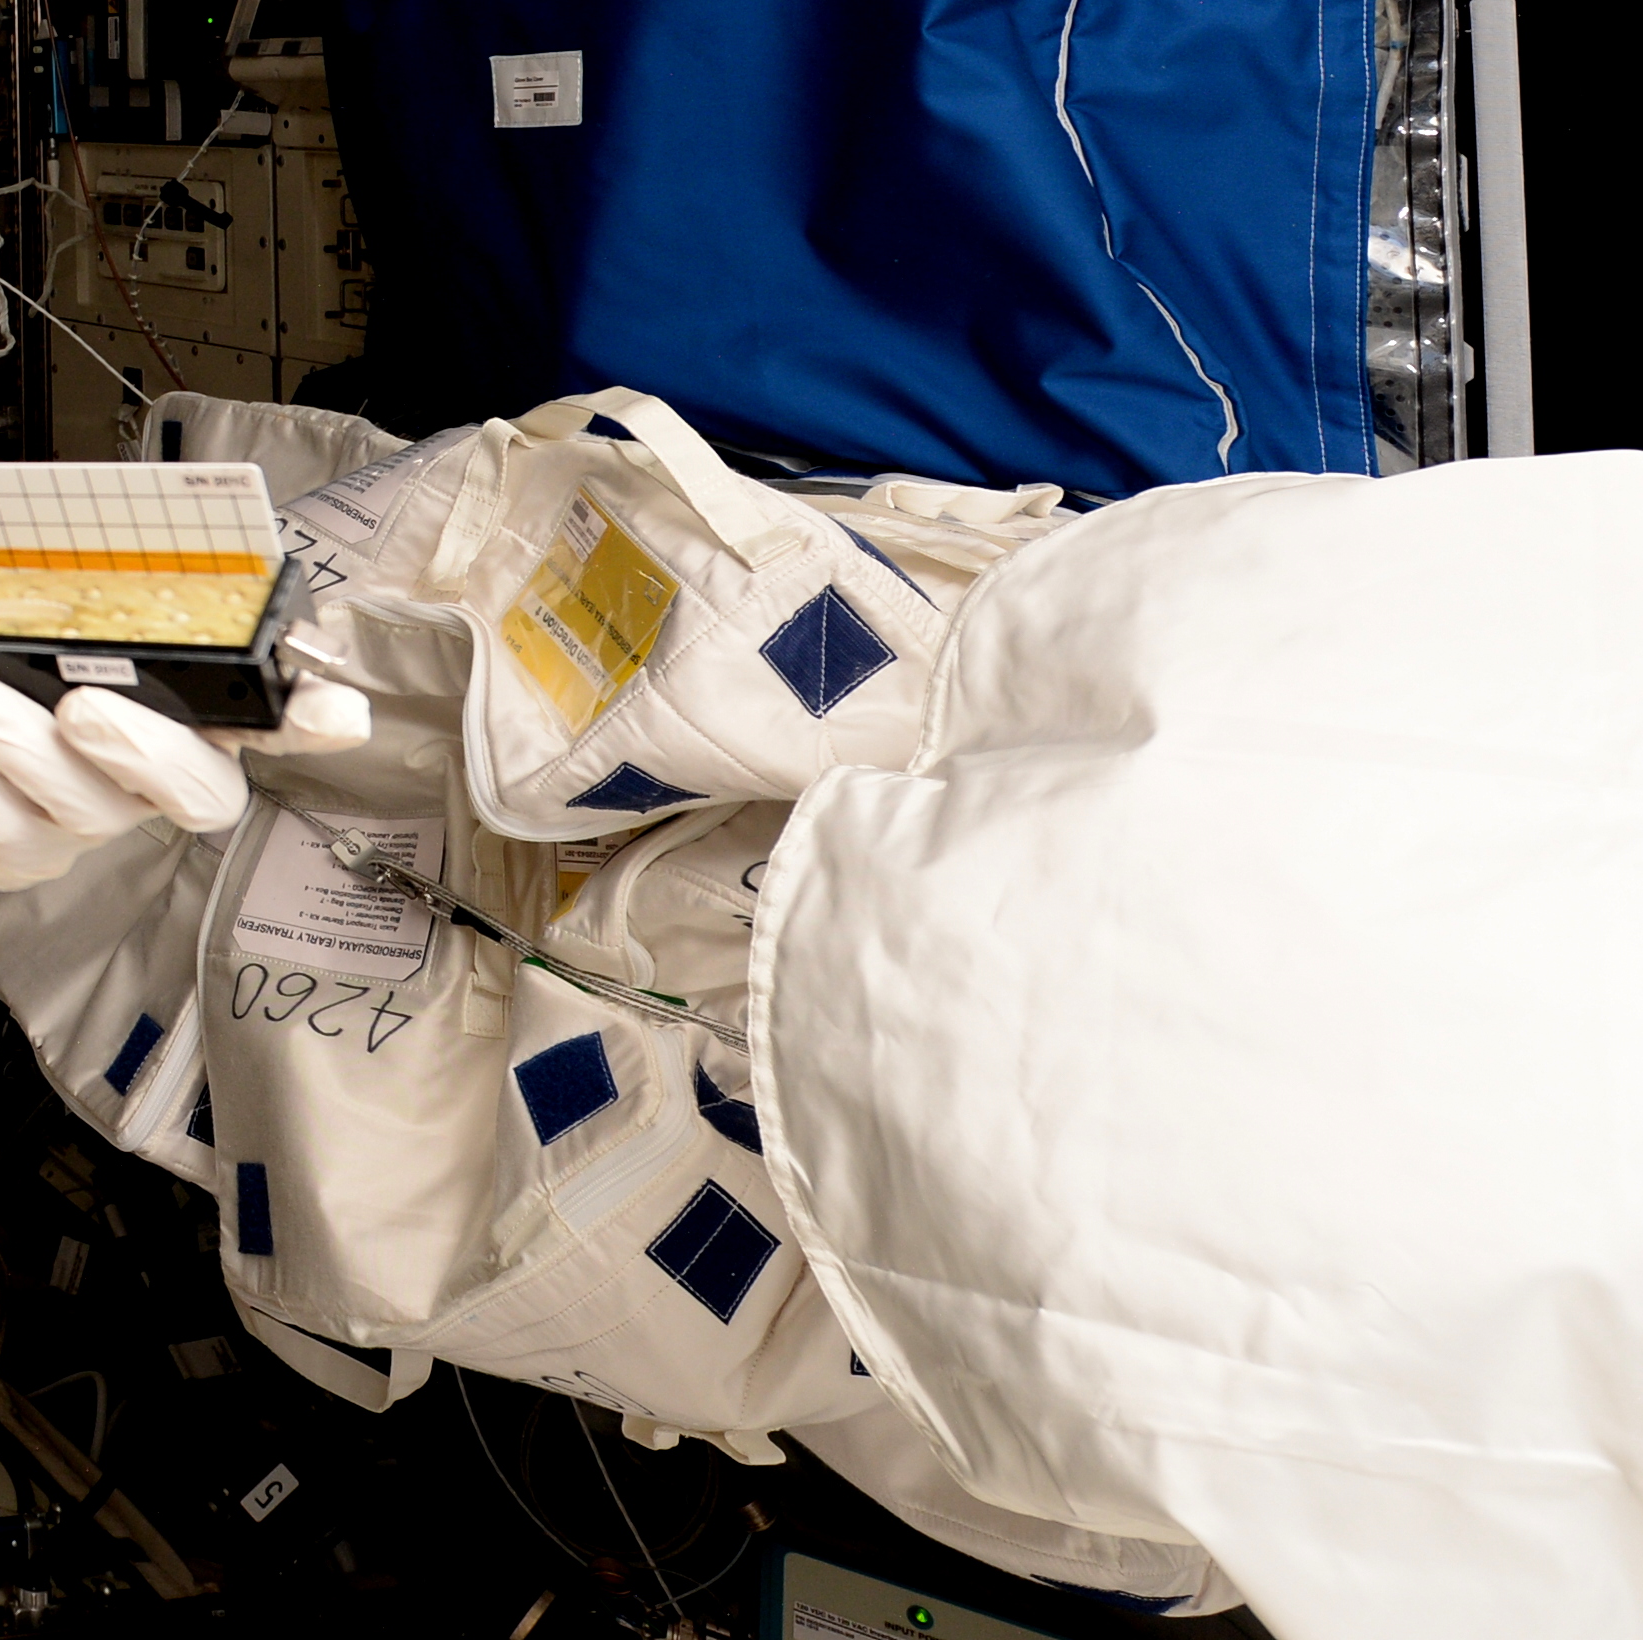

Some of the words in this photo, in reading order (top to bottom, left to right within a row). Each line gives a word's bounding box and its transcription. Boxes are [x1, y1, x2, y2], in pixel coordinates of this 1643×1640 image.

[537, 609, 581, 657] Direction
[571, 648, 606, 684] Launch
[346, 901, 372, 911] Fixation
[357, 912, 390, 922] Dosimeter
[373, 904, 403, 914] Chemical
[236, 916, 295, 941] TRANSFER)
[346, 919, 378, 931] Transport
[296, 931, 337, 950] (EARLY
[338, 939, 423, 961] SPHEROIDS/JAXA
[231, 963, 414, 1054] 4260
[253, 1479, 284, 1510] 5
[810, 1607, 826, 1619] VDC
[852, 1622, 868, 1633] VAC
[884, 1620, 915, 1638] INPUT
